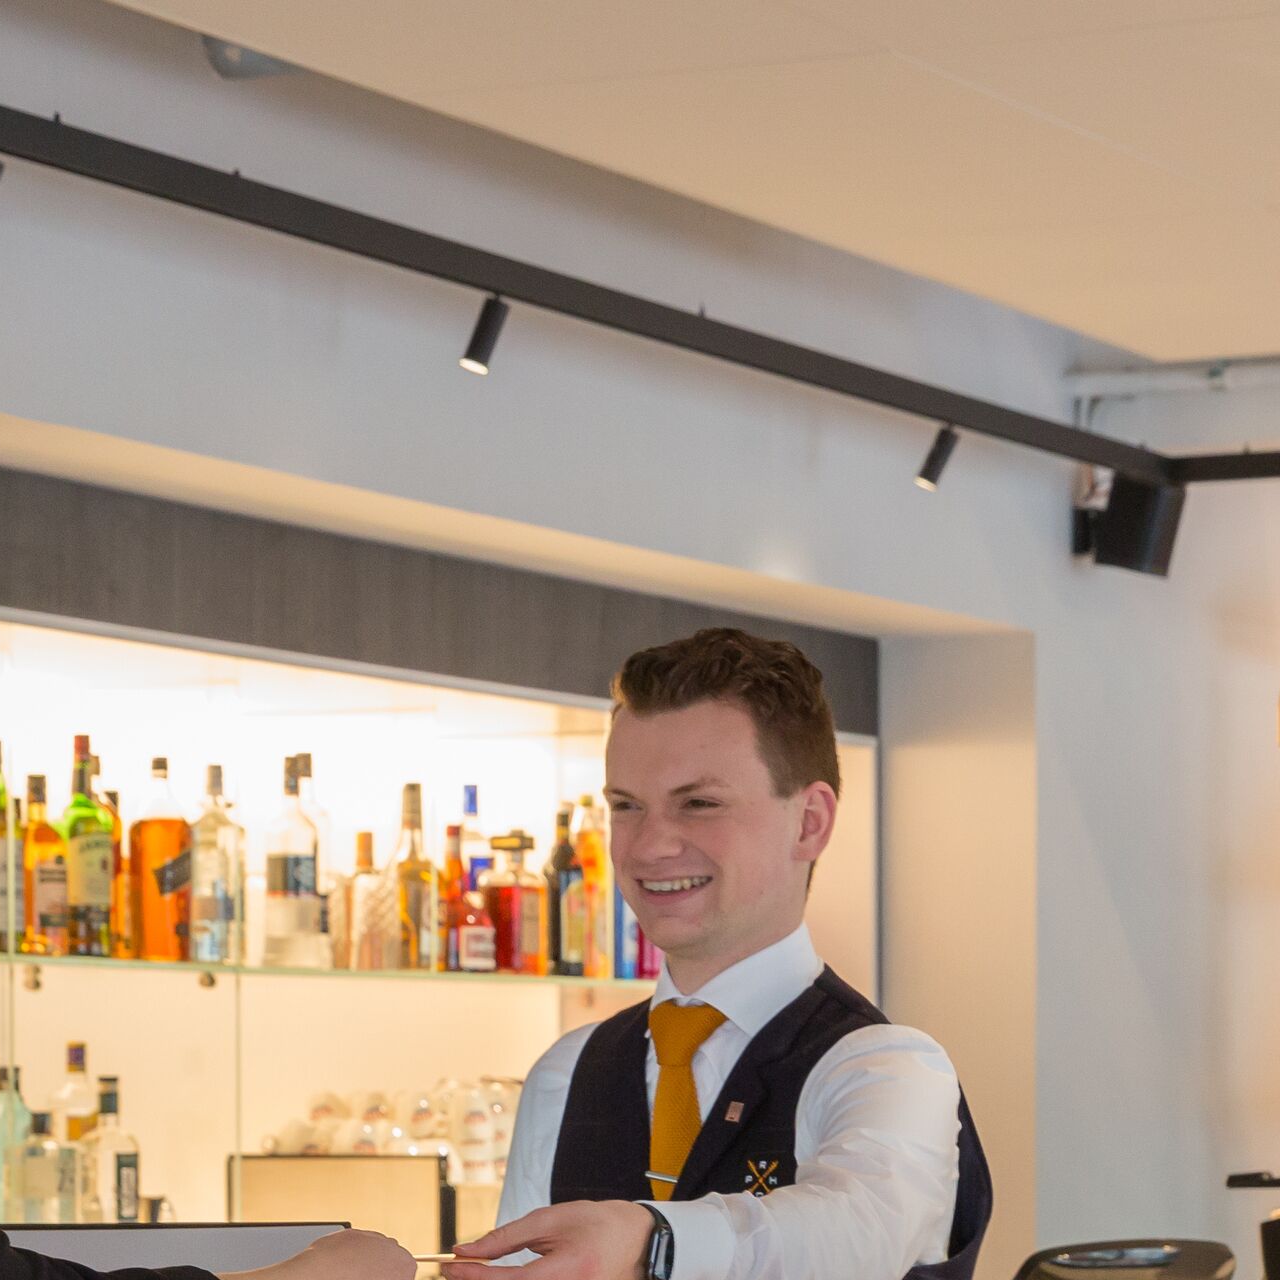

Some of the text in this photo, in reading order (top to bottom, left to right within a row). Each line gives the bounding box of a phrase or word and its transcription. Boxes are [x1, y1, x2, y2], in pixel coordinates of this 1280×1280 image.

[759, 1160, 767, 1170] R
[744, 1175, 753, 1184] P
[768, 1176, 778, 1185] H
